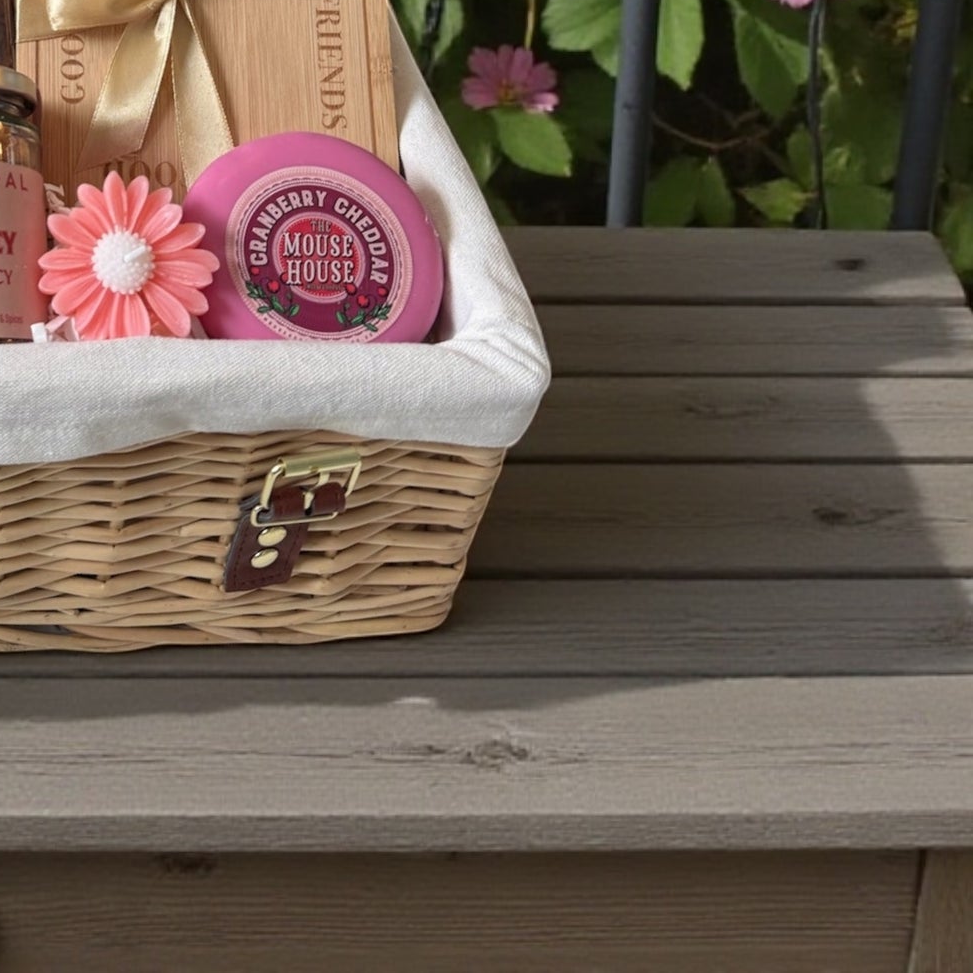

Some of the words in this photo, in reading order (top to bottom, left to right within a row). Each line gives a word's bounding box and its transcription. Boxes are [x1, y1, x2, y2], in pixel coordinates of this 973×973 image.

[60, 34, 85, 104] GOO
[249, 190, 327, 266] CRANBERRY
[334, 197, 389, 285] CHEDDAR
[310, 221, 332, 232] THE
[283, 232, 354, 257] MOUSE
[286, 259, 355, 285] HOUSE
